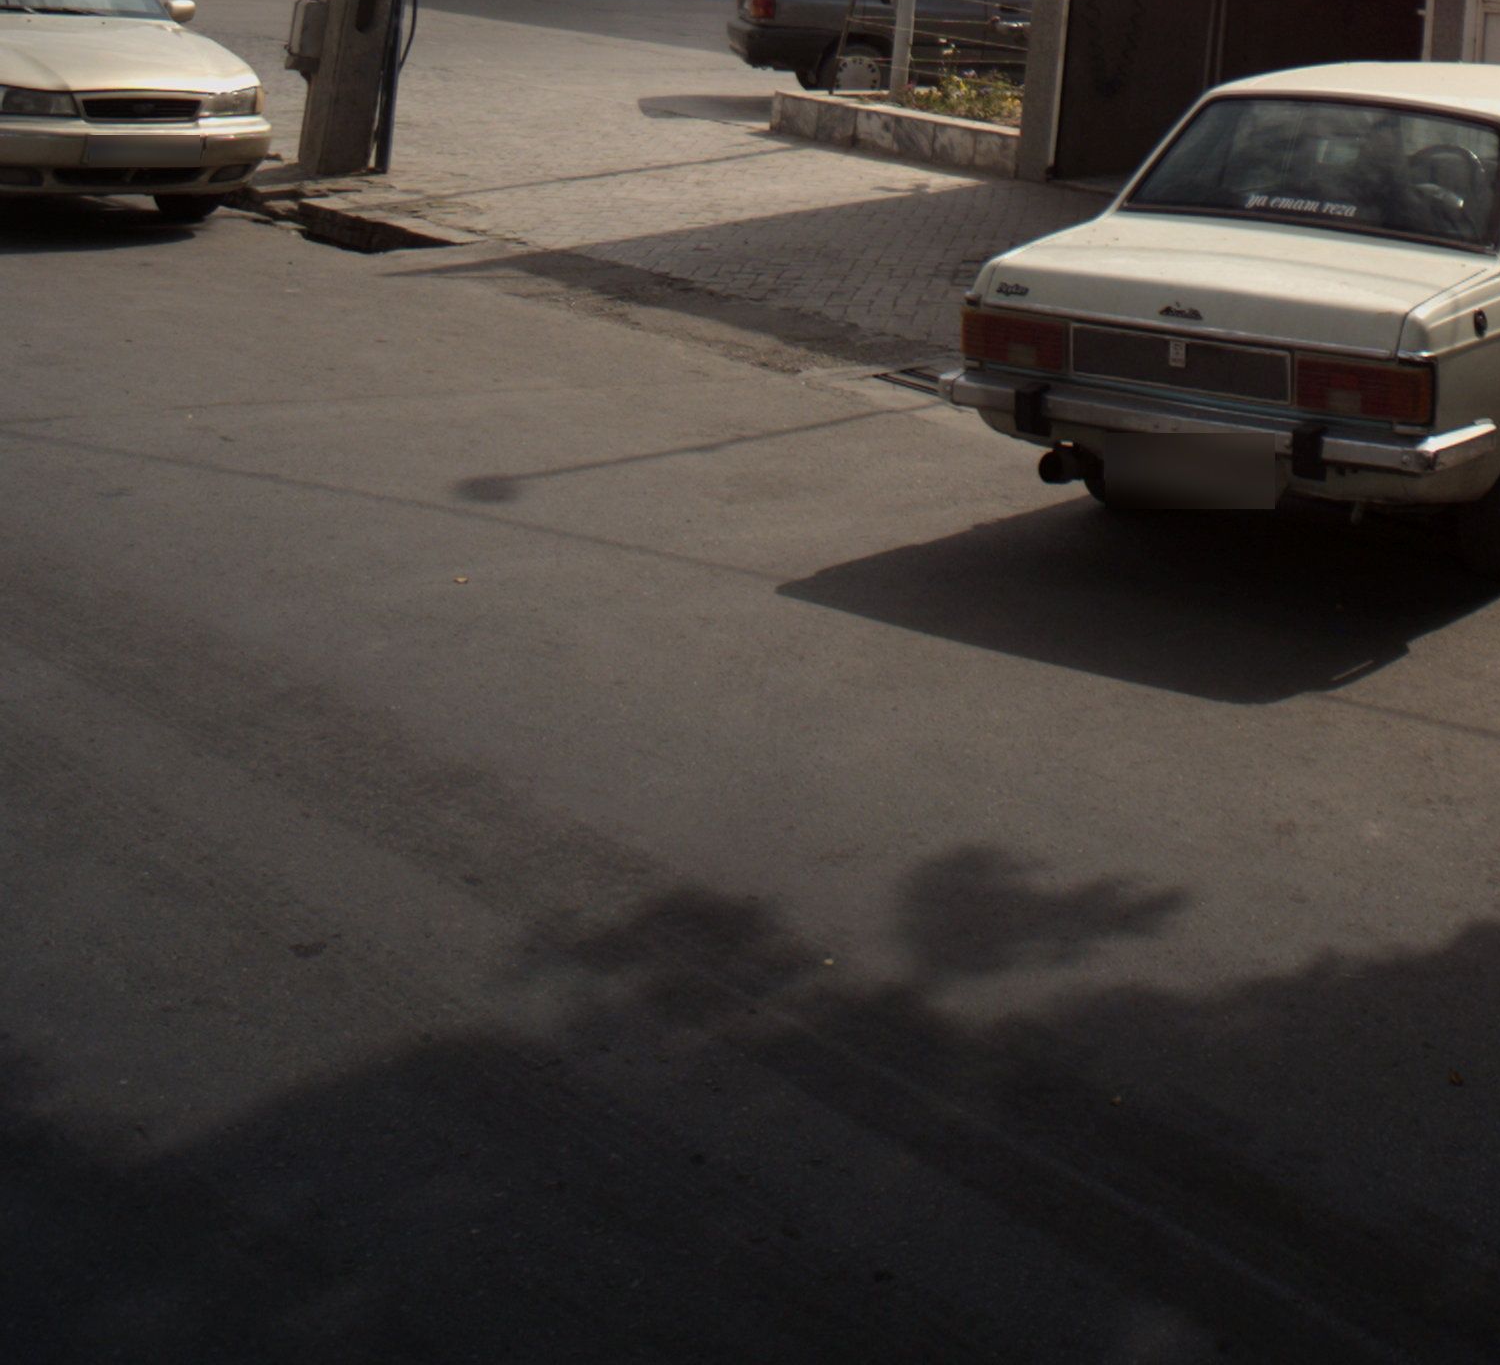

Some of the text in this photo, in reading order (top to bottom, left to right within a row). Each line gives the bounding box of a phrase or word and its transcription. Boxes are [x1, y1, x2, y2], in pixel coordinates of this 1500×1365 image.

[1247, 195, 1358, 217] ya emam reza
